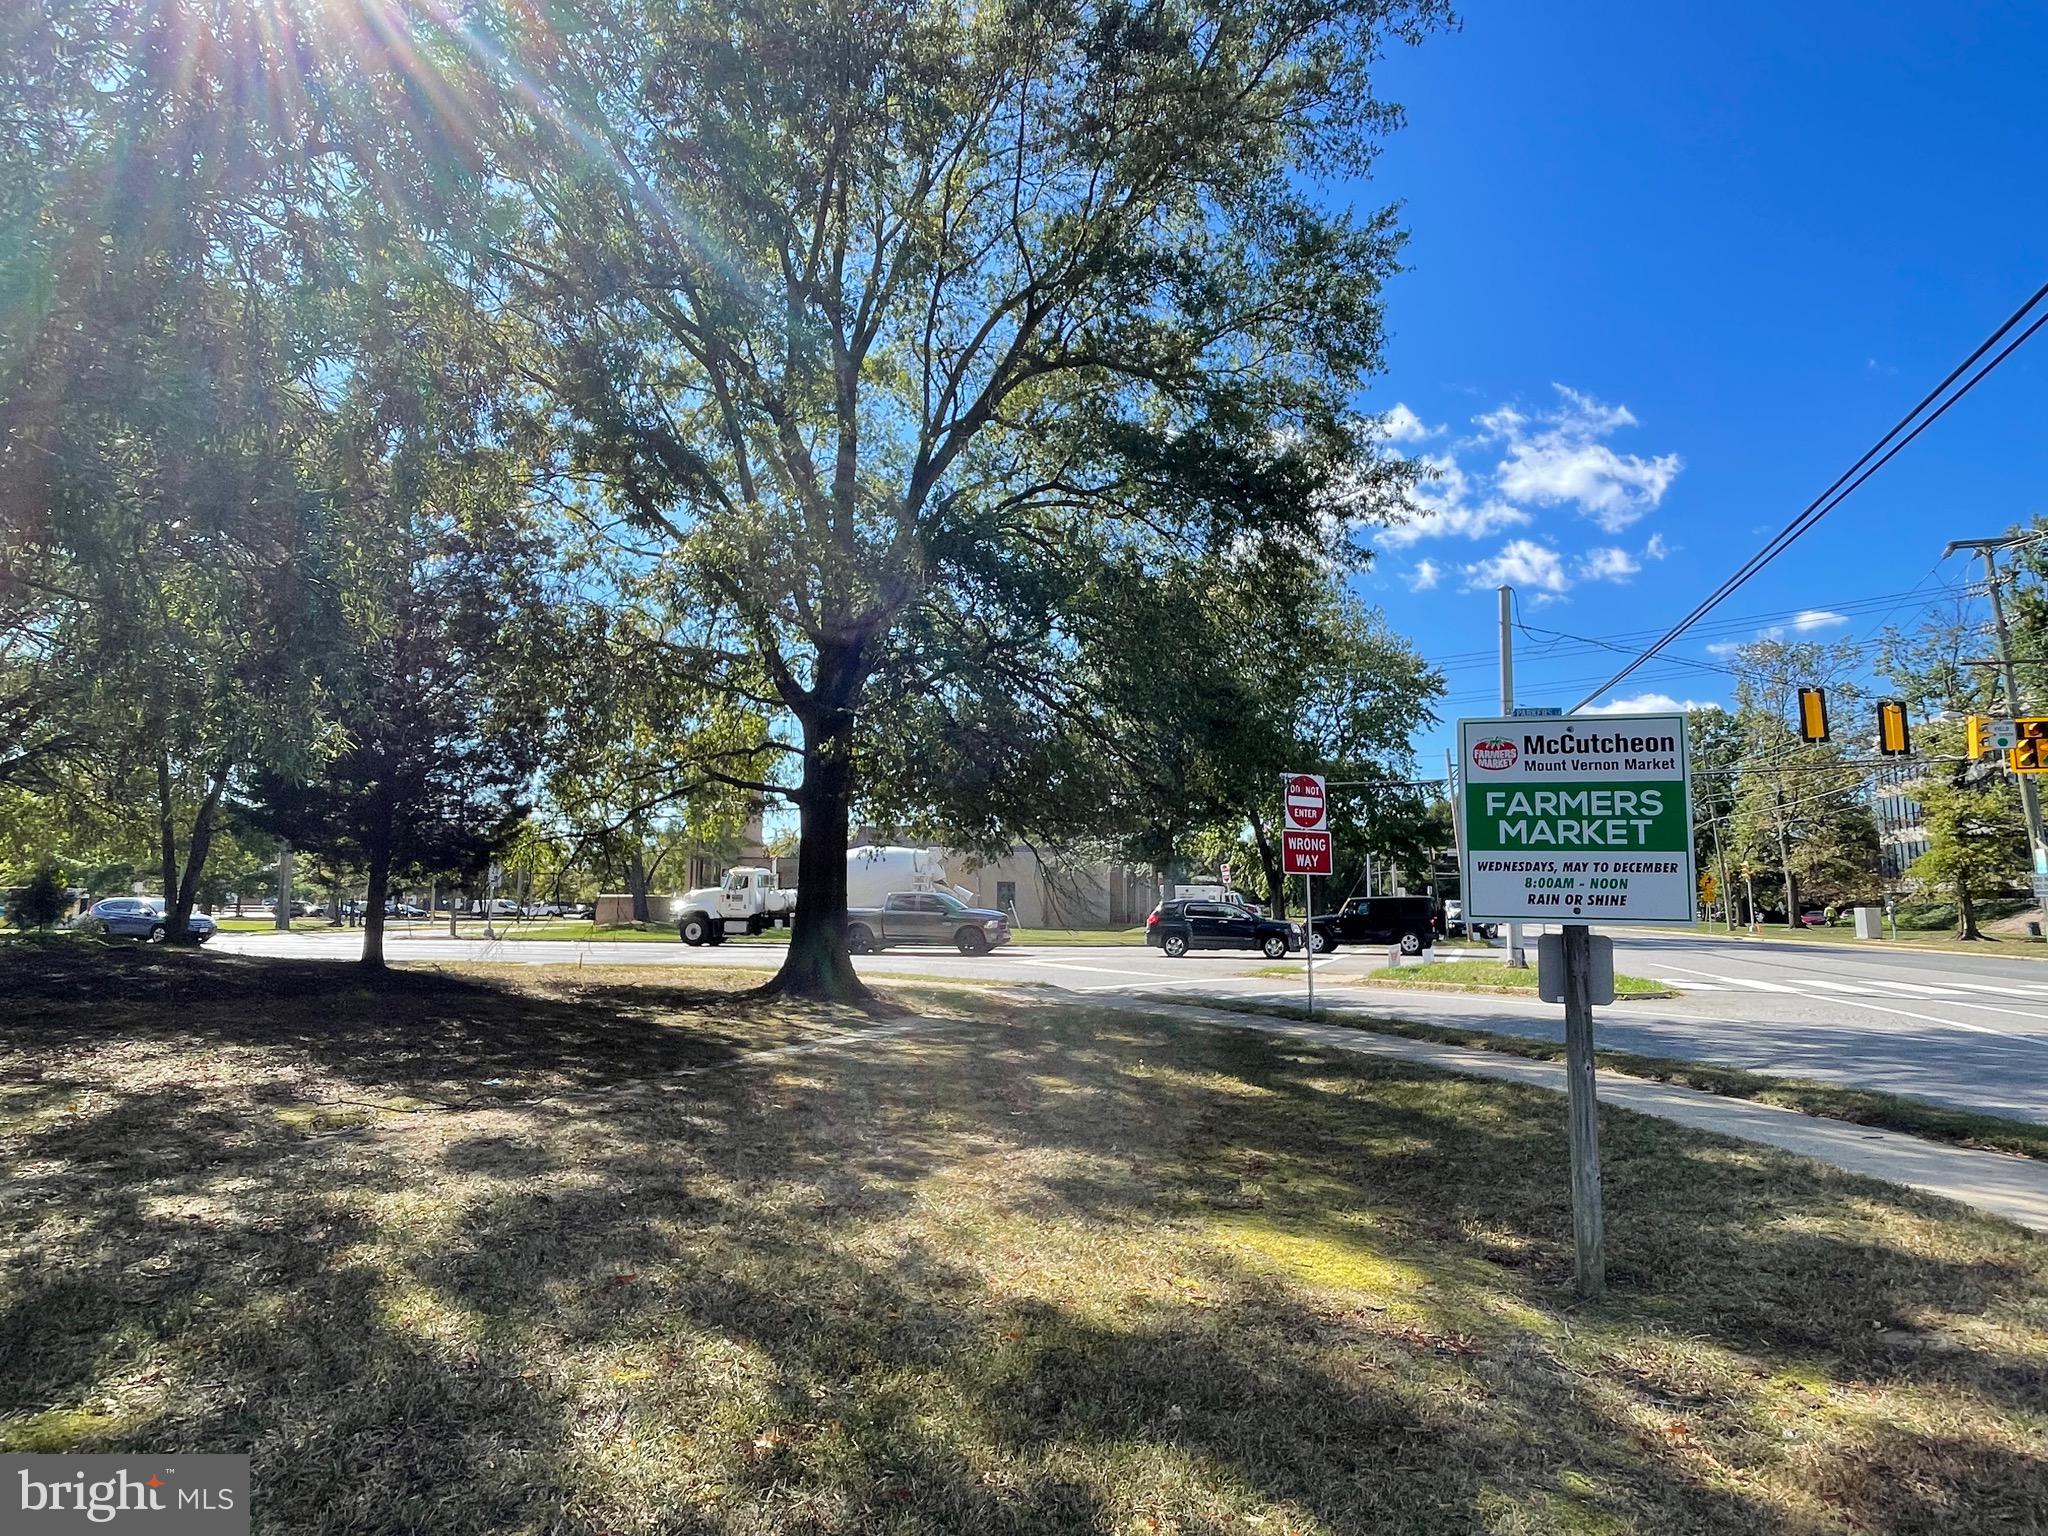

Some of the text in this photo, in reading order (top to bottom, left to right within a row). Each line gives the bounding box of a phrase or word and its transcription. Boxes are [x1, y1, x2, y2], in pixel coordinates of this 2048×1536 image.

[1524, 734, 1674, 754] McCutcheon
[1474, 749, 1516, 759] FARMERS
[1478, 758, 1513, 768] MARKET
[1524, 758, 1675, 771] Mount Vernon Market
[1290, 785, 1319, 795] DO NOT
[1487, 790, 1664, 816] FARMERS
[1294, 808, 1317, 818] ENTER
[1499, 819, 1653, 845] MARKET
[1288, 837, 1326, 851] WRONG
[1296, 854, 1319, 867] WAY
[1477, 861, 1679, 874] WEDNESDAYS, MAY TO DECEMBER
[1525, 878, 1574, 889] 8:00AM
[1590, 878, 1628, 889] NOON
[1528, 894, 1627, 906] RAIN OR SHINE
